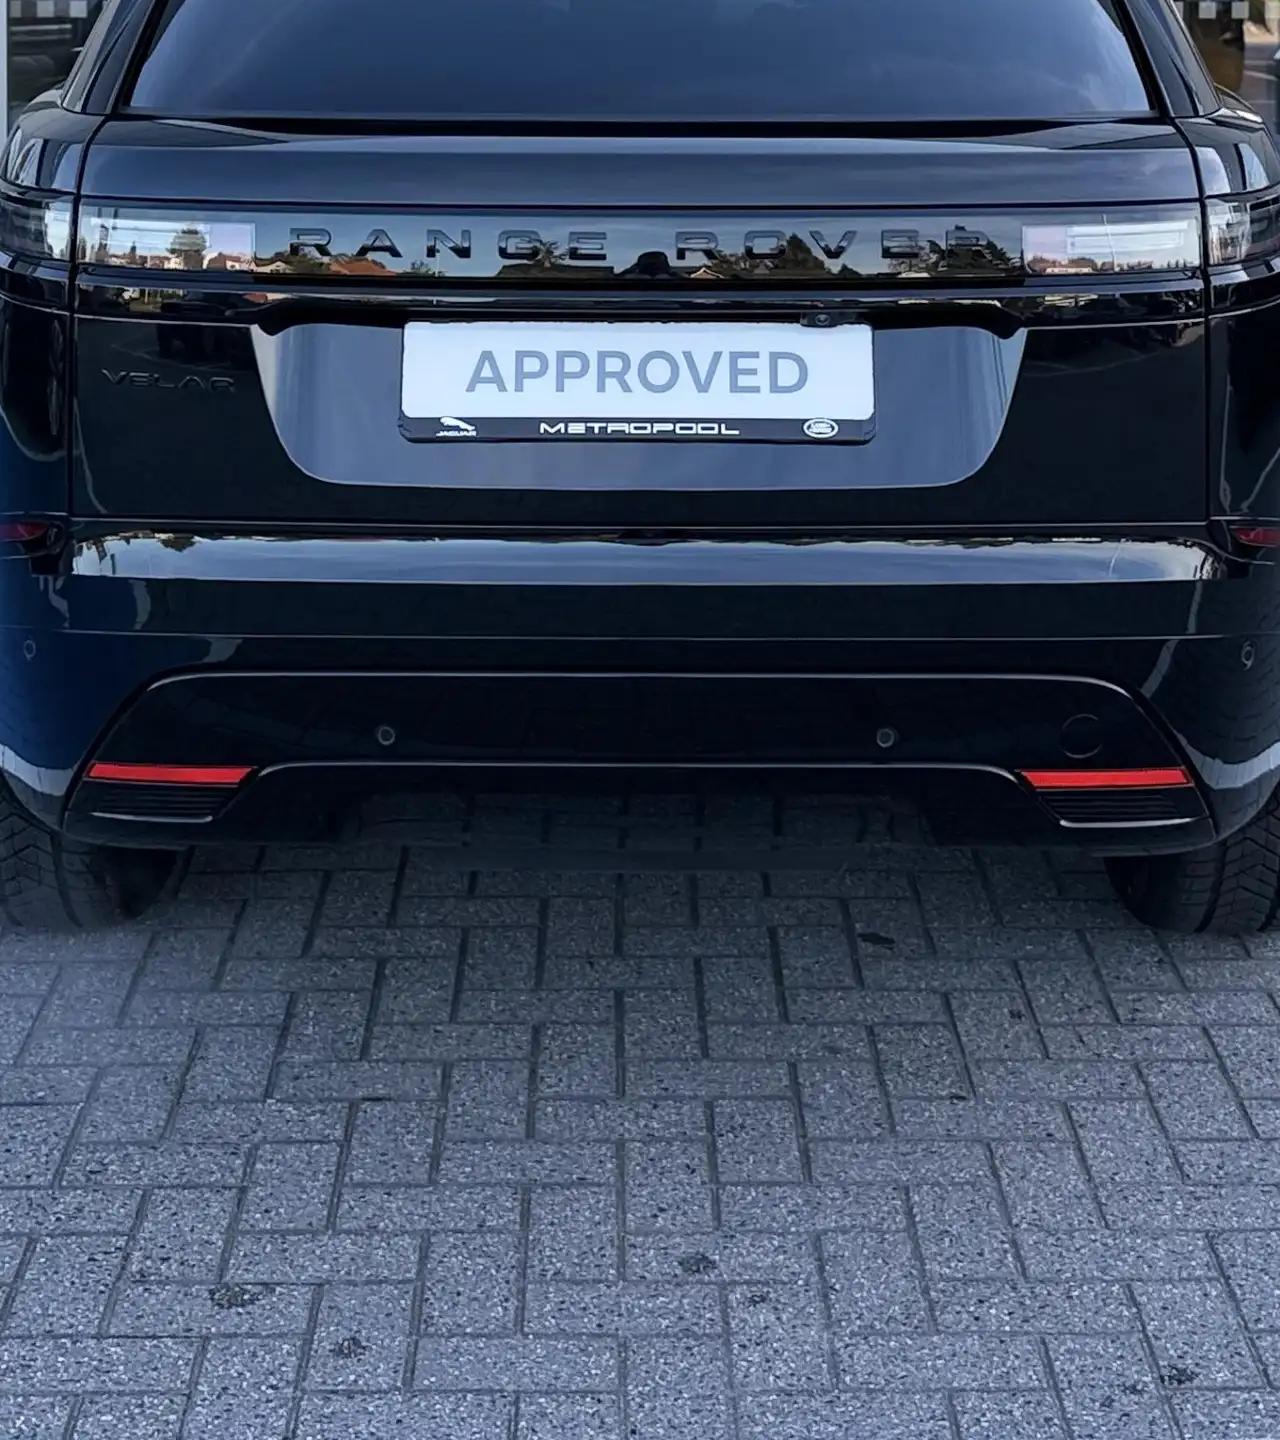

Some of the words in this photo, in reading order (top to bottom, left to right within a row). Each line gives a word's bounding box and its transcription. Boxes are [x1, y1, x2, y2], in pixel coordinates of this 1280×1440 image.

[289, 231, 610, 261] RANGE
[675, 230, 993, 261] ROVER
[101, 368, 236, 393] VELAR
[465, 349, 809, 395] APPROVED
[539, 421, 741, 436] METROPOOL
